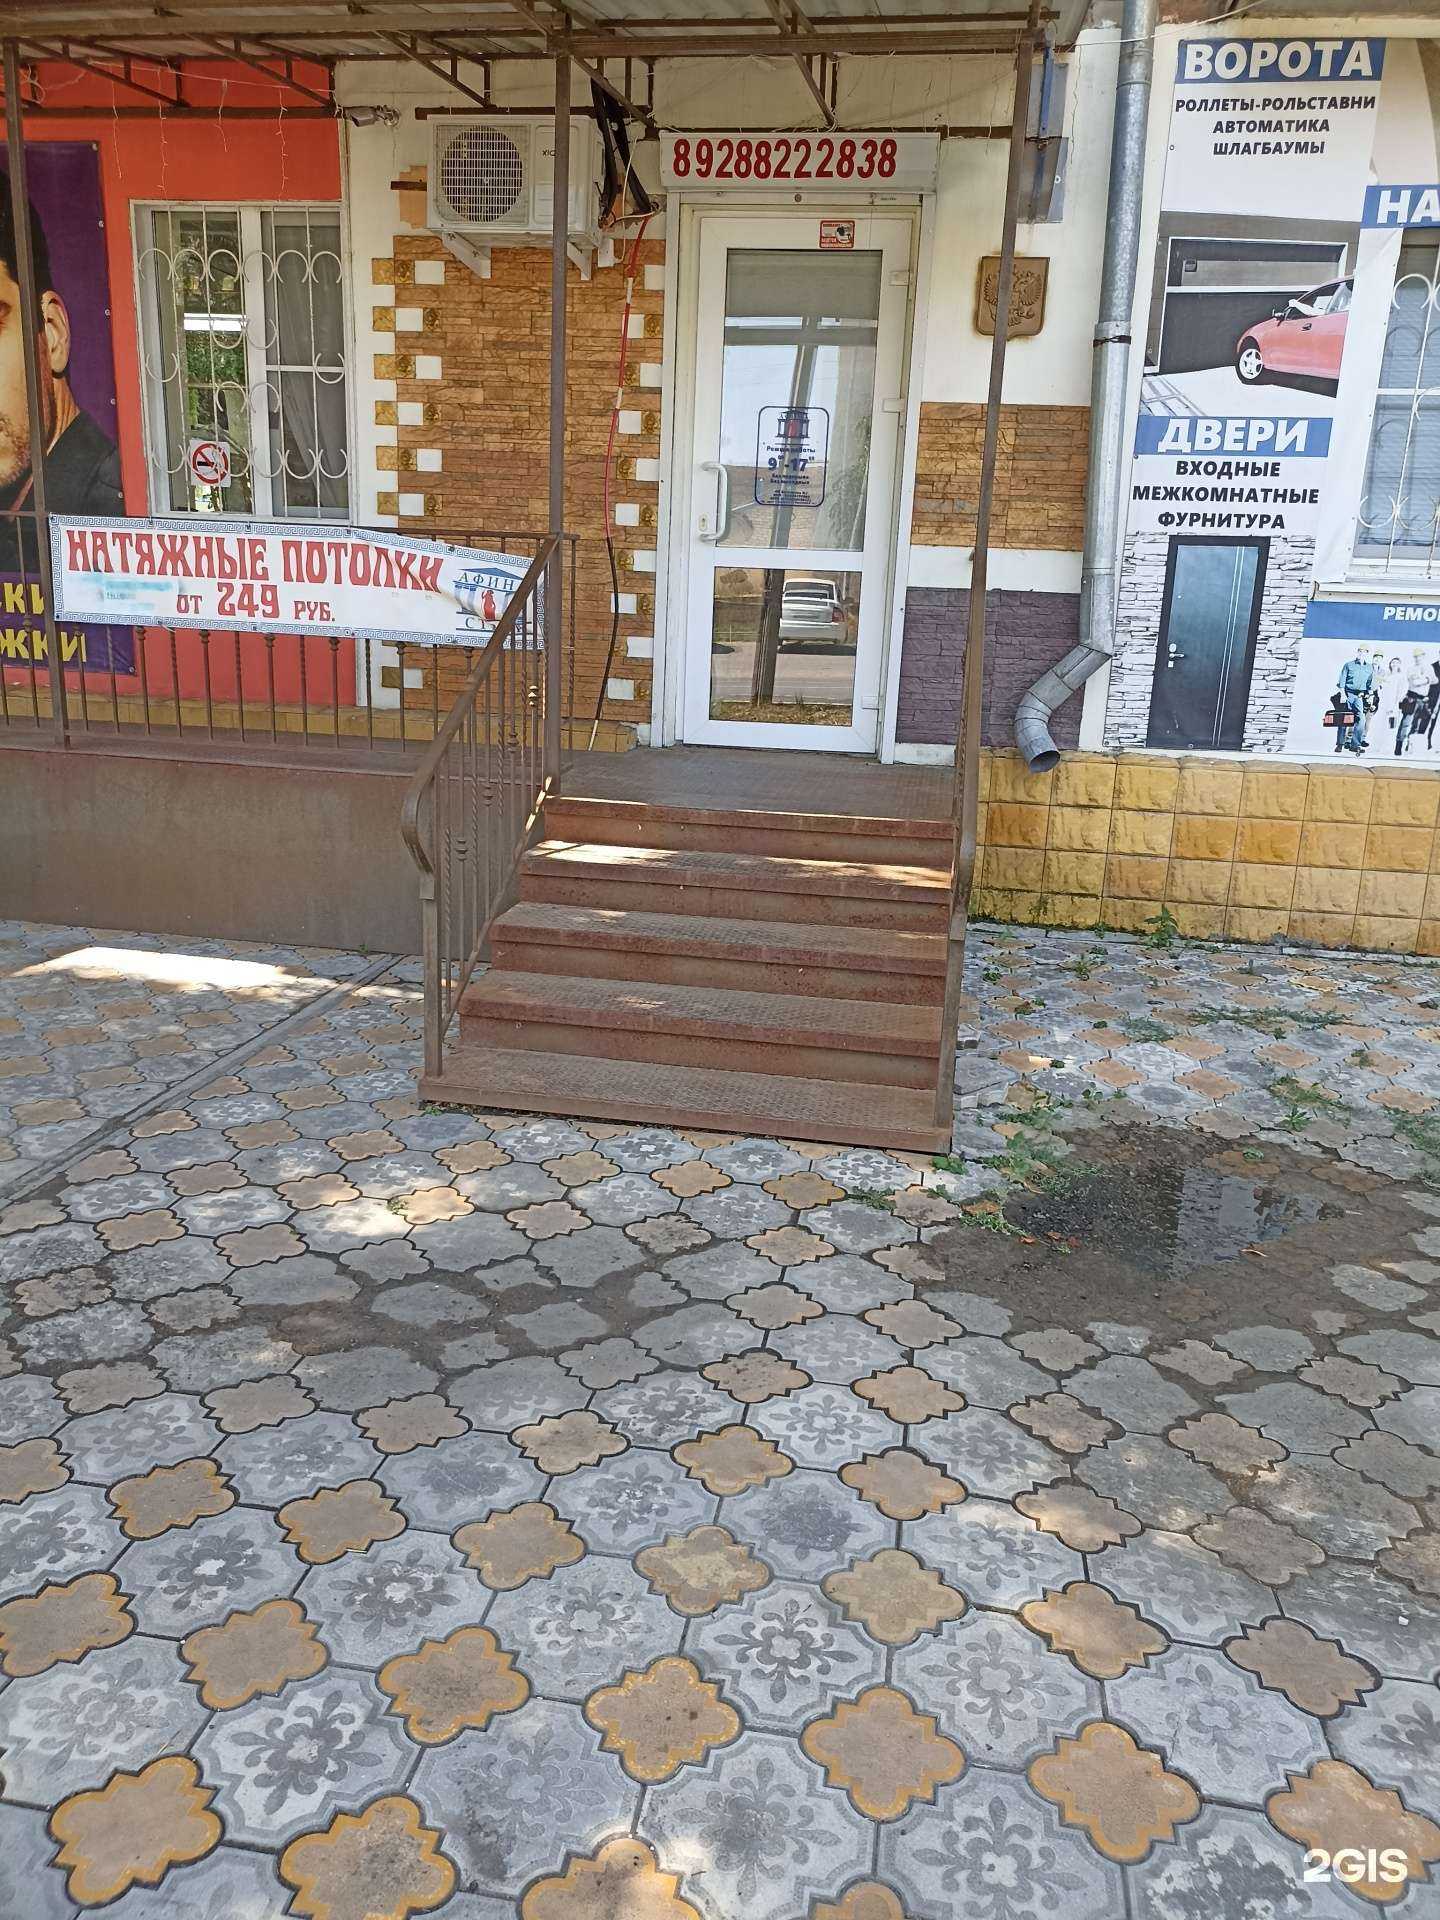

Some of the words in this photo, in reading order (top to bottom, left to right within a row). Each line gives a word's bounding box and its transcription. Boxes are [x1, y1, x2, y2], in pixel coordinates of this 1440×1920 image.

[1183, 40, 1373, 80] ВОРОТА
[1175, 95, 1376, 113] РОЛЛЕТЫ-РОЛЬСТАВНИ
[1212, 118, 1330, 134] АВТОМАТИКА
[1213, 140, 1326, 156] ШЛАГБАУМЫ
[673, 138, 898, 179] 89288222838
[1157, 417, 1309, 453] ДВЕРИ
[1175, 460, 1281, 480] ВХОДНЫЕ
[1132, 485, 1320, 504] МЕЖКОМНАТНЫЕ
[1158, 511, 1286, 530] ФУРНИТУРА
[66, 529, 269, 581] НАТЯЖНЫЕ
[282, 540, 445, 594] ПОТОЛКИ
[176, 593, 202, 615] ОТ
[217, 581, 280, 619] 249
[294, 600, 336, 622] РУБ.
[1383, 606, 1440, 622] РЕМО
